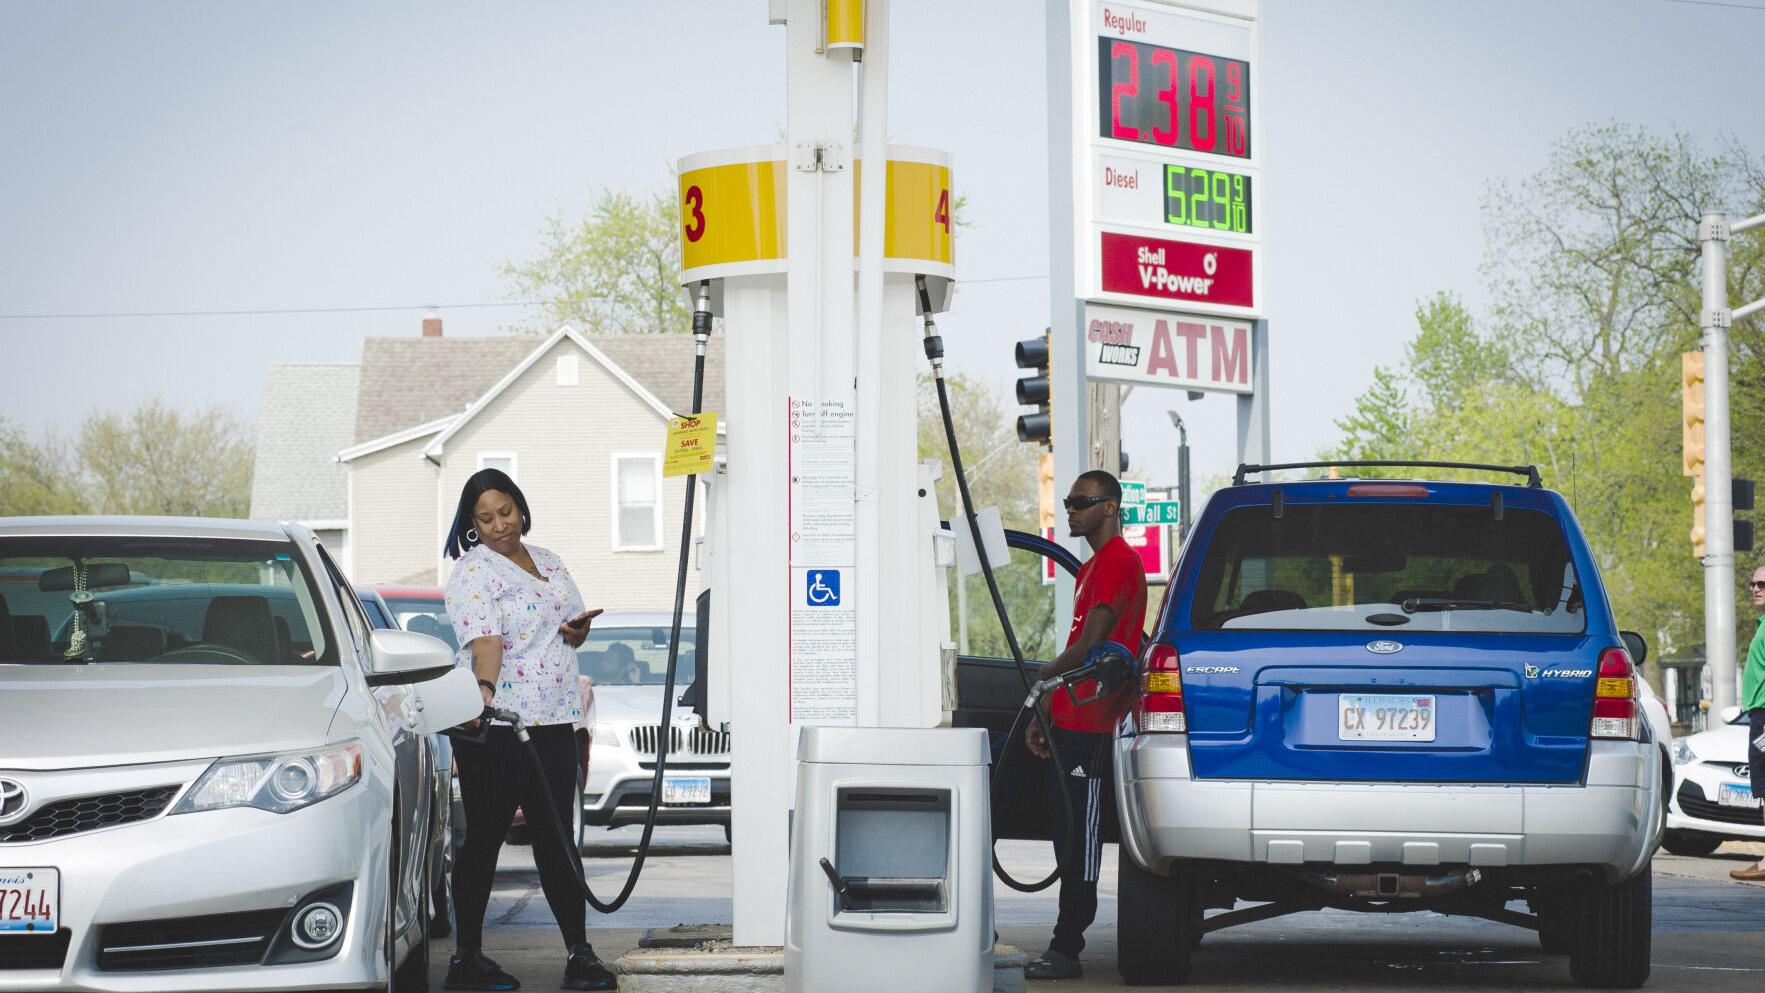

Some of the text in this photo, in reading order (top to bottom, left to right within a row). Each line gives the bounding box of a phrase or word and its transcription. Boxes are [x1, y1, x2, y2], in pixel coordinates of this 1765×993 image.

[1104, 8, 1146, 35] Regular
[1111, 42, 1216, 152] 2.38
[1105, 167, 1139, 190] Diesel
[1167, 164, 1231, 231] 5.29
[685, 185, 706, 243] 3
[934, 189, 950, 234] 4
[1138, 246, 1166, 266] Shell
[1138, 265, 1211, 295] V-Power
[1088, 319, 1133, 345] CASH
[1101, 346, 1138, 365] WORKS
[1146, 319, 1249, 385] ATM
[680, 420, 701, 429] SHOP
[681, 439, 699, 448] SAVE
[1137, 504, 1160, 522] Wall
[1166, 505, 1177, 520] St
[1186, 666, 1241, 674] ESCAPE
[1541, 669, 1593, 678] HYBRID
[1343, 707, 1431, 730] CX 97239
